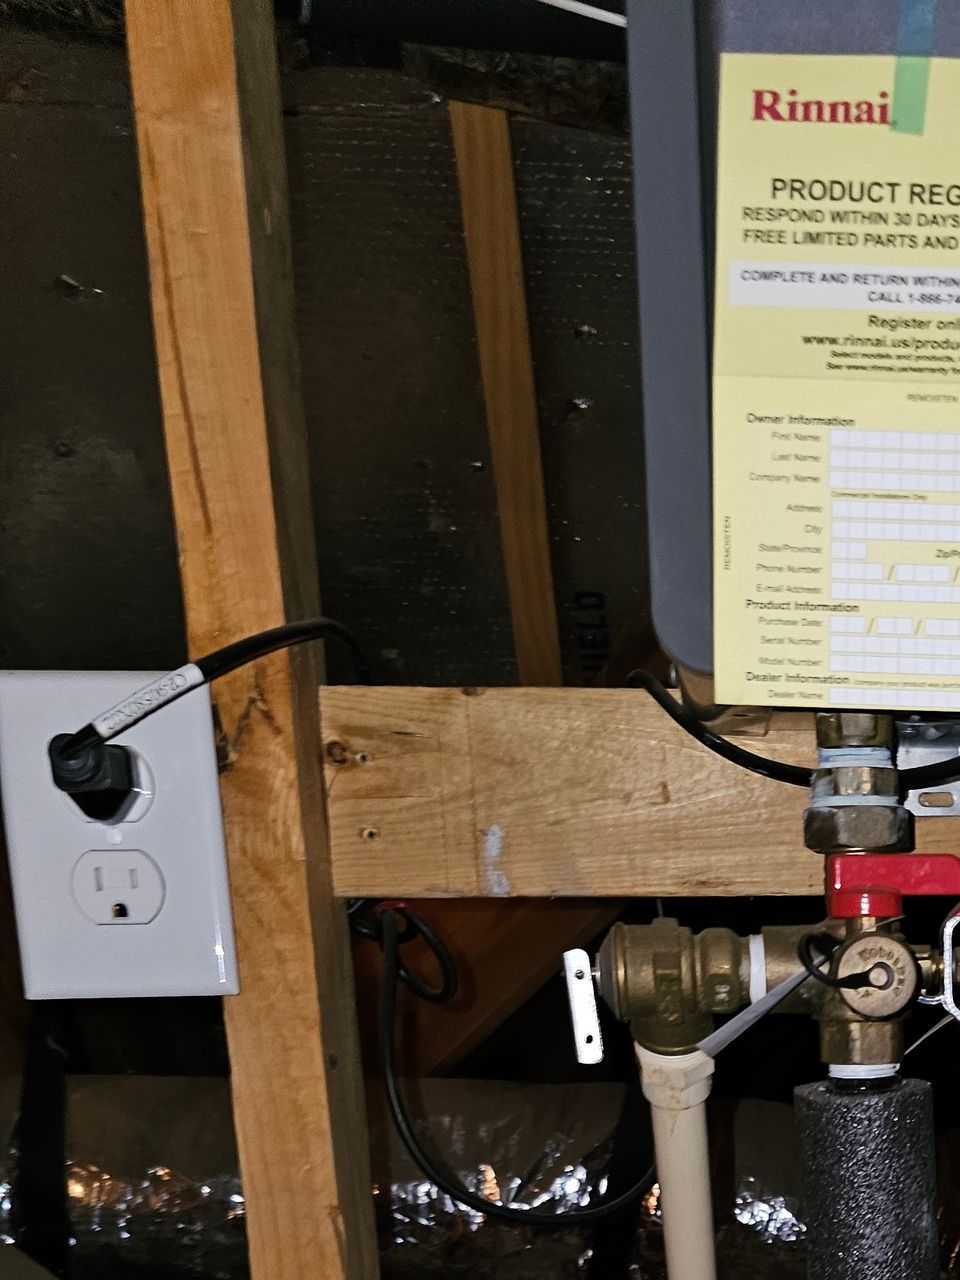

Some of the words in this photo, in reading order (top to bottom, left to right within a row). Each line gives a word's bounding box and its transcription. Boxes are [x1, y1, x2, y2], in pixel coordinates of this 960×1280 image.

[752, 88, 890, 125] Rinnai
[771, 178, 900, 203] PRODUCT
[742, 207, 825, 223] RESPOND
[829, 210, 889, 225] WITHIN
[894, 212, 913, 227] 30
[742, 229, 788, 245] FREE
[793, 231, 859, 248] LIMITED
[863, 233, 919, 249] PARTS
[923, 236, 959, 251] AND
[740, 270, 816, 284] COMPLETE
[820, 272, 848, 285] AND
[853, 273, 908, 287] RETURN
[868, 291, 902, 304] CALL
[868, 315, 932, 331] Register
[746, 412, 785, 424] Owner
[788, 414, 856, 427] Information
[746, 598, 791, 611] Product
[794, 601, 859, 613] Information
[746, 671, 782, 682] Dealer
[785, 673, 850, 685] Information
